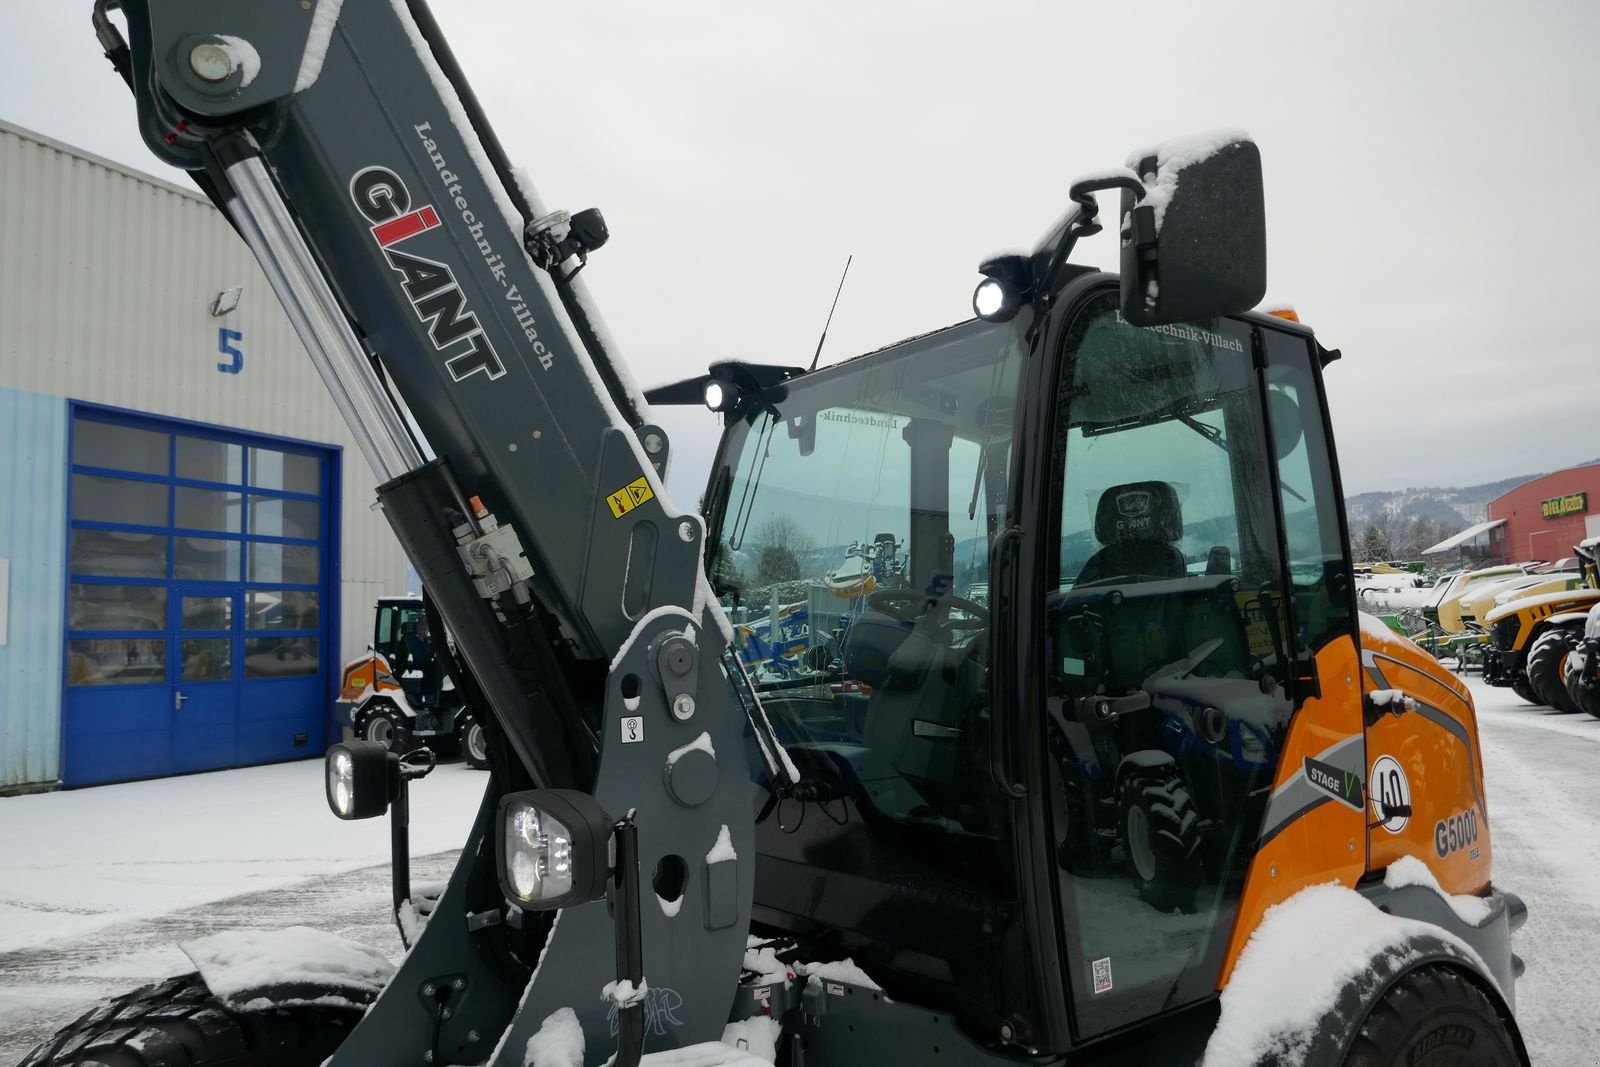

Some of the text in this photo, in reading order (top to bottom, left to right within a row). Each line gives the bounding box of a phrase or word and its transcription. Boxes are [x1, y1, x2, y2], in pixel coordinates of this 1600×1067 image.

[414, 121, 554, 372] Landtechnik-Villach
[217, 327, 244, 375] 5
[1311, 766, 1356, 799] STAGE V
[1434, 807, 1479, 859] G5000
